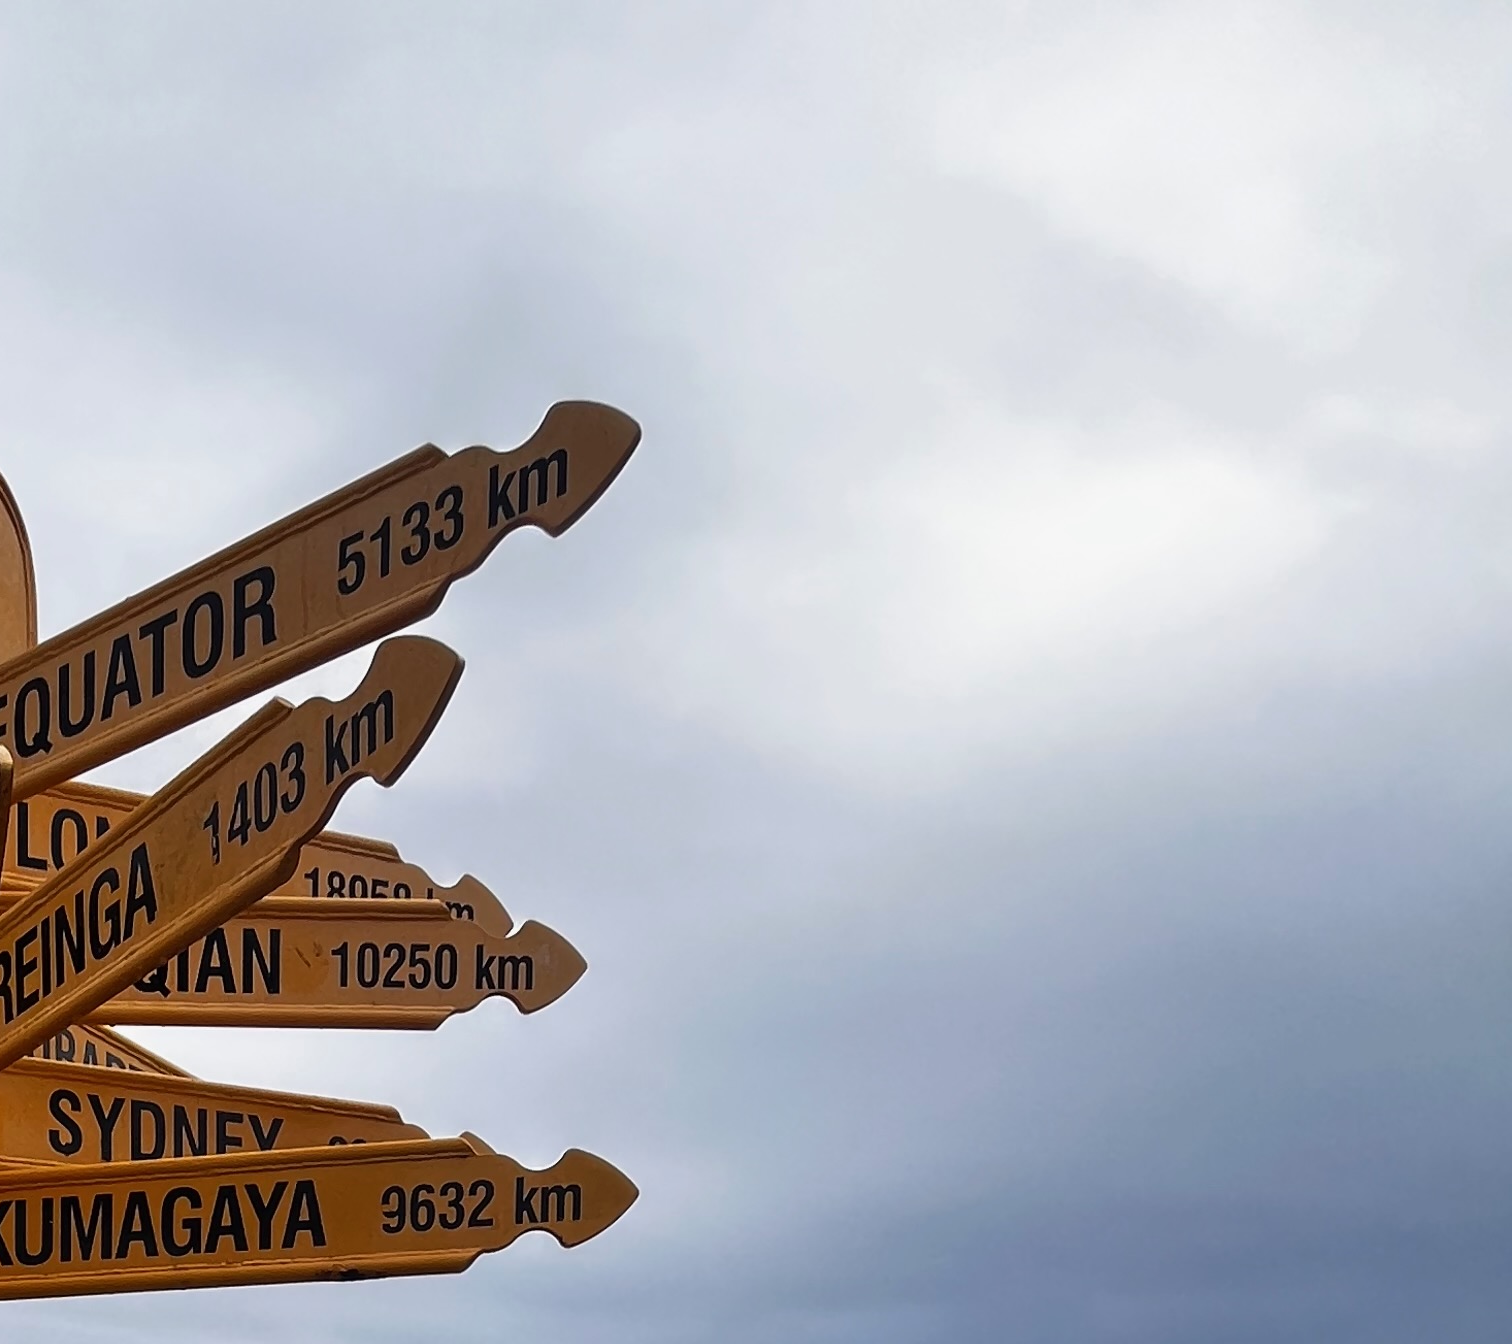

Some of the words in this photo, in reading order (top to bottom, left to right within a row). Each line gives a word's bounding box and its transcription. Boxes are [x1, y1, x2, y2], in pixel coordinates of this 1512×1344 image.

[337, 484, 465, 597] 5133
[488, 446, 569, 529] km
[202, 741, 307, 865] 1403
[324, 688, 395, 787] km
[330, 940, 458, 989] 10250
[474, 944, 534, 990] km
[381, 1179, 496, 1235] 9632
[514, 1176, 583, 1225] km
